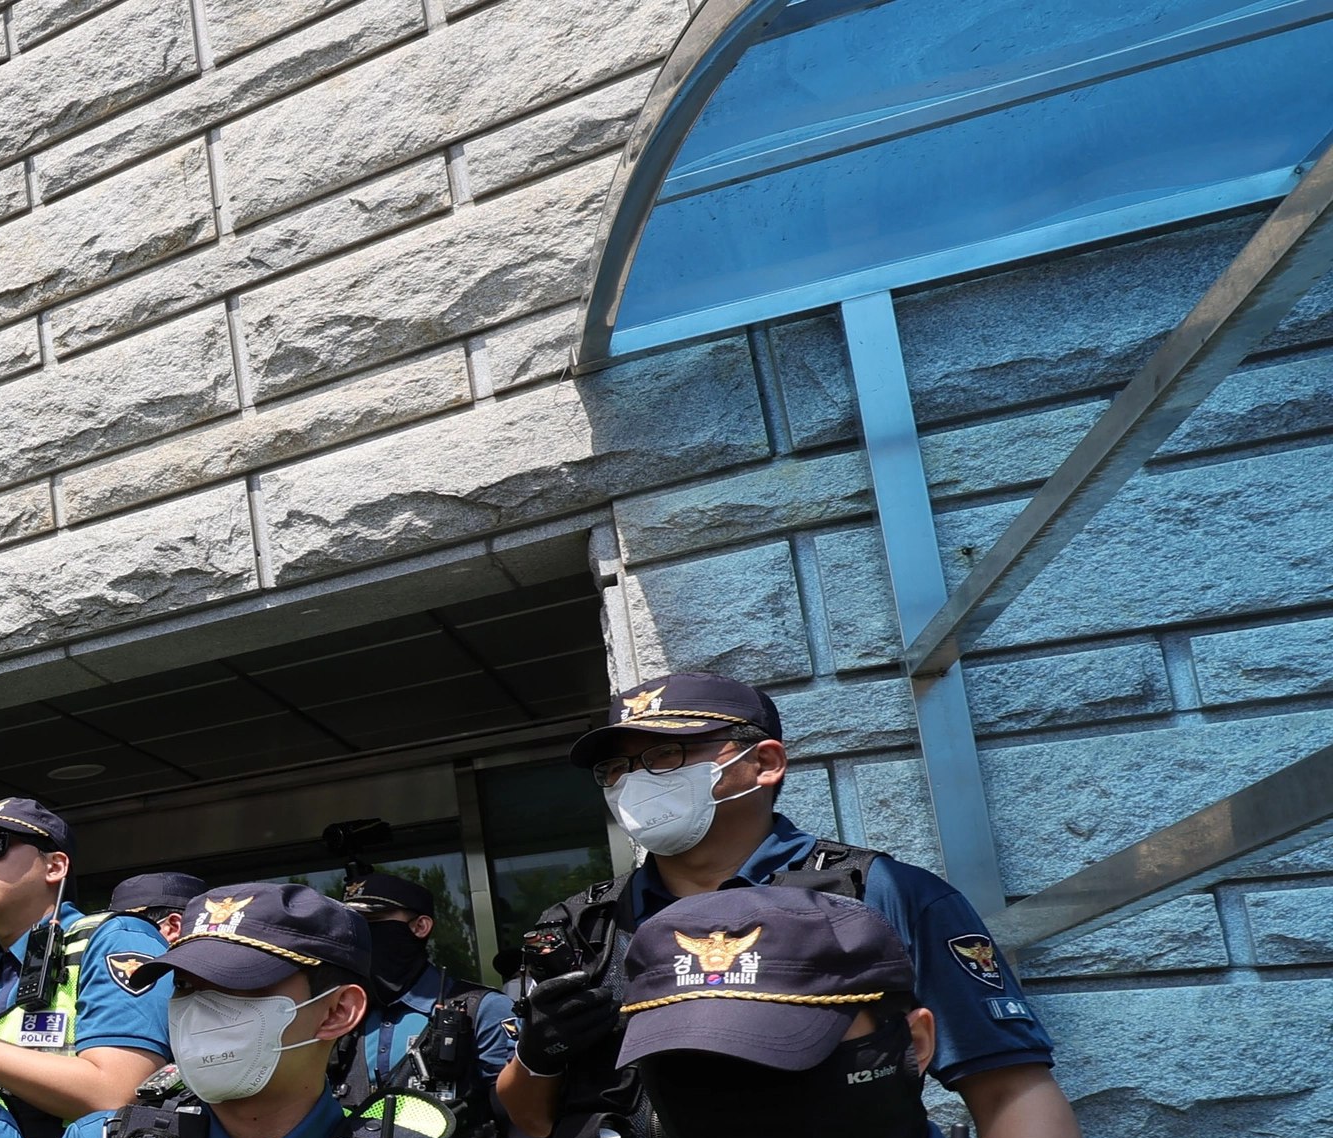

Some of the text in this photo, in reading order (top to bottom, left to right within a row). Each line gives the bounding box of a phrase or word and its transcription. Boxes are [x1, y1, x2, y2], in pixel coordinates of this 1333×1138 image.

[24, 1014, 61, 1031] 경찰
[21, 1034, 58, 1042] POLICE
[202, 1051, 235, 1064] KF-94
[251, 1066, 268, 1088] korea
[847, 1070, 873, 1084] K2
